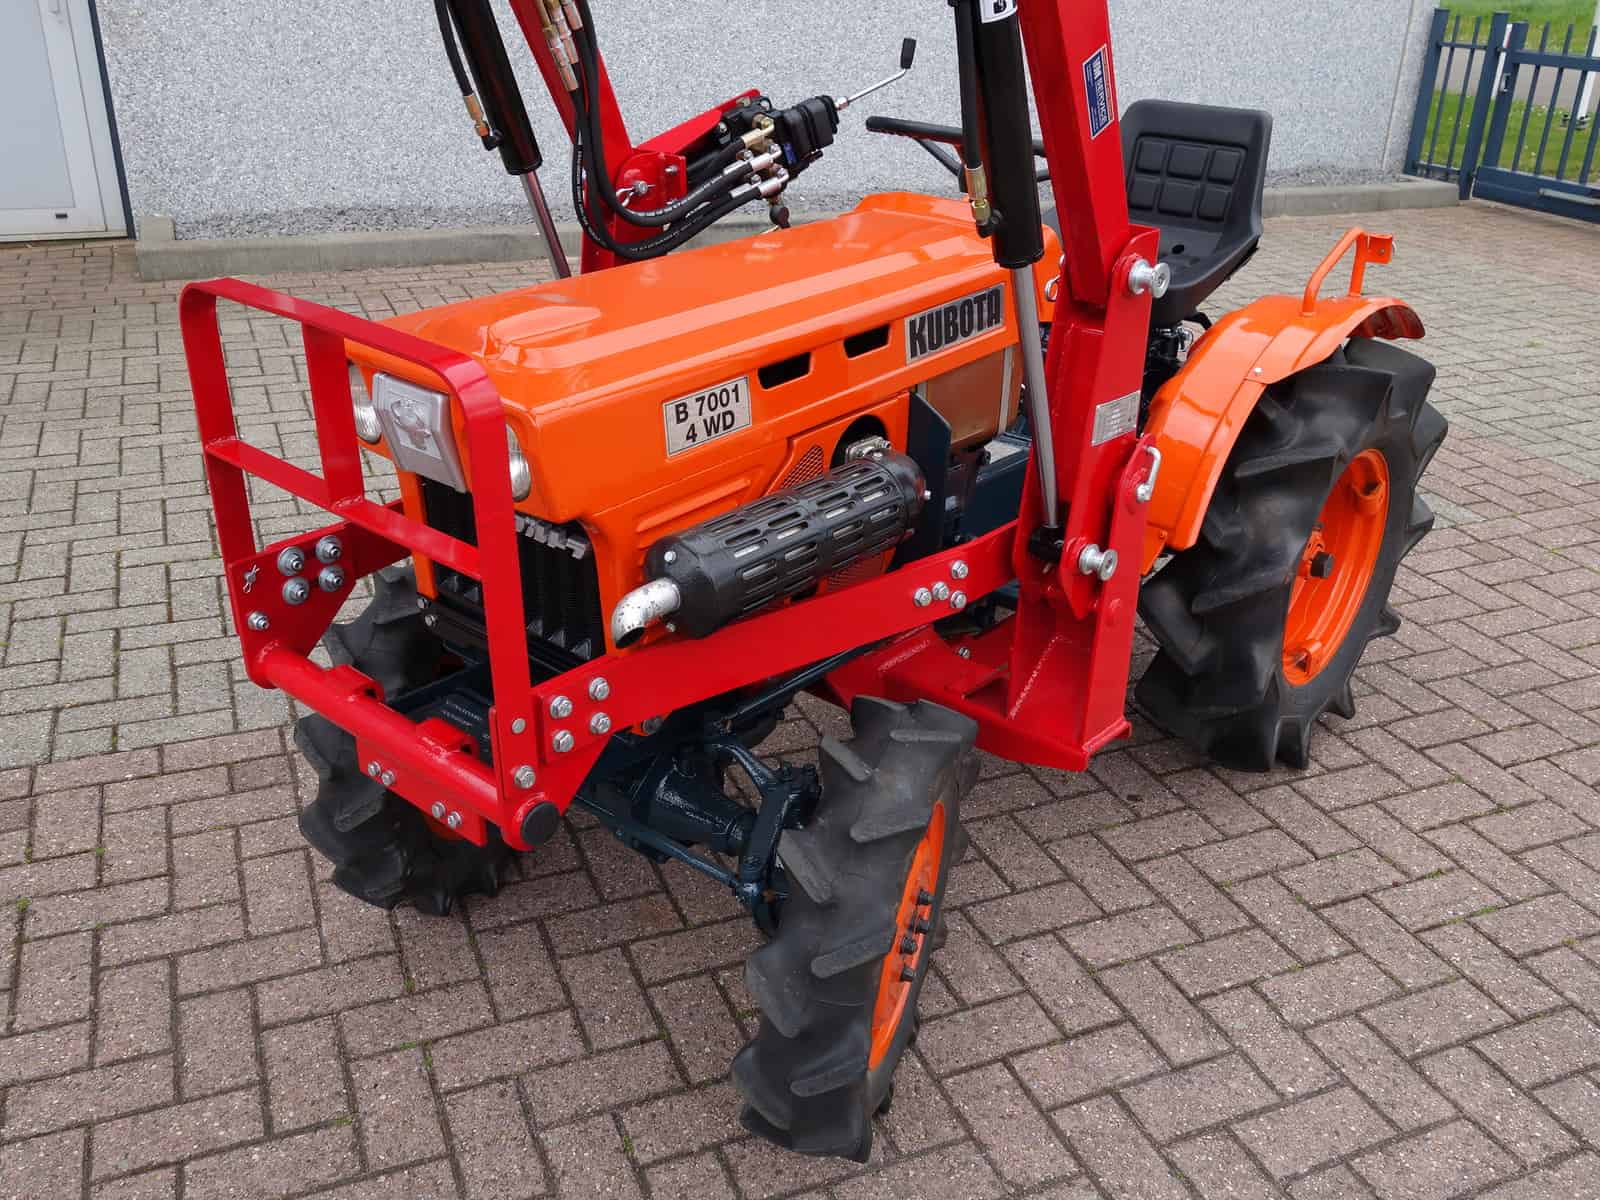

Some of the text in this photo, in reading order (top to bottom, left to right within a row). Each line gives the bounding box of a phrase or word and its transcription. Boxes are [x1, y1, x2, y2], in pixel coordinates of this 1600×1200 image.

[909, 288, 1001, 359] KUBOTA
[674, 383, 740, 424] B 7001
[685, 410, 735, 443] 4 WD
